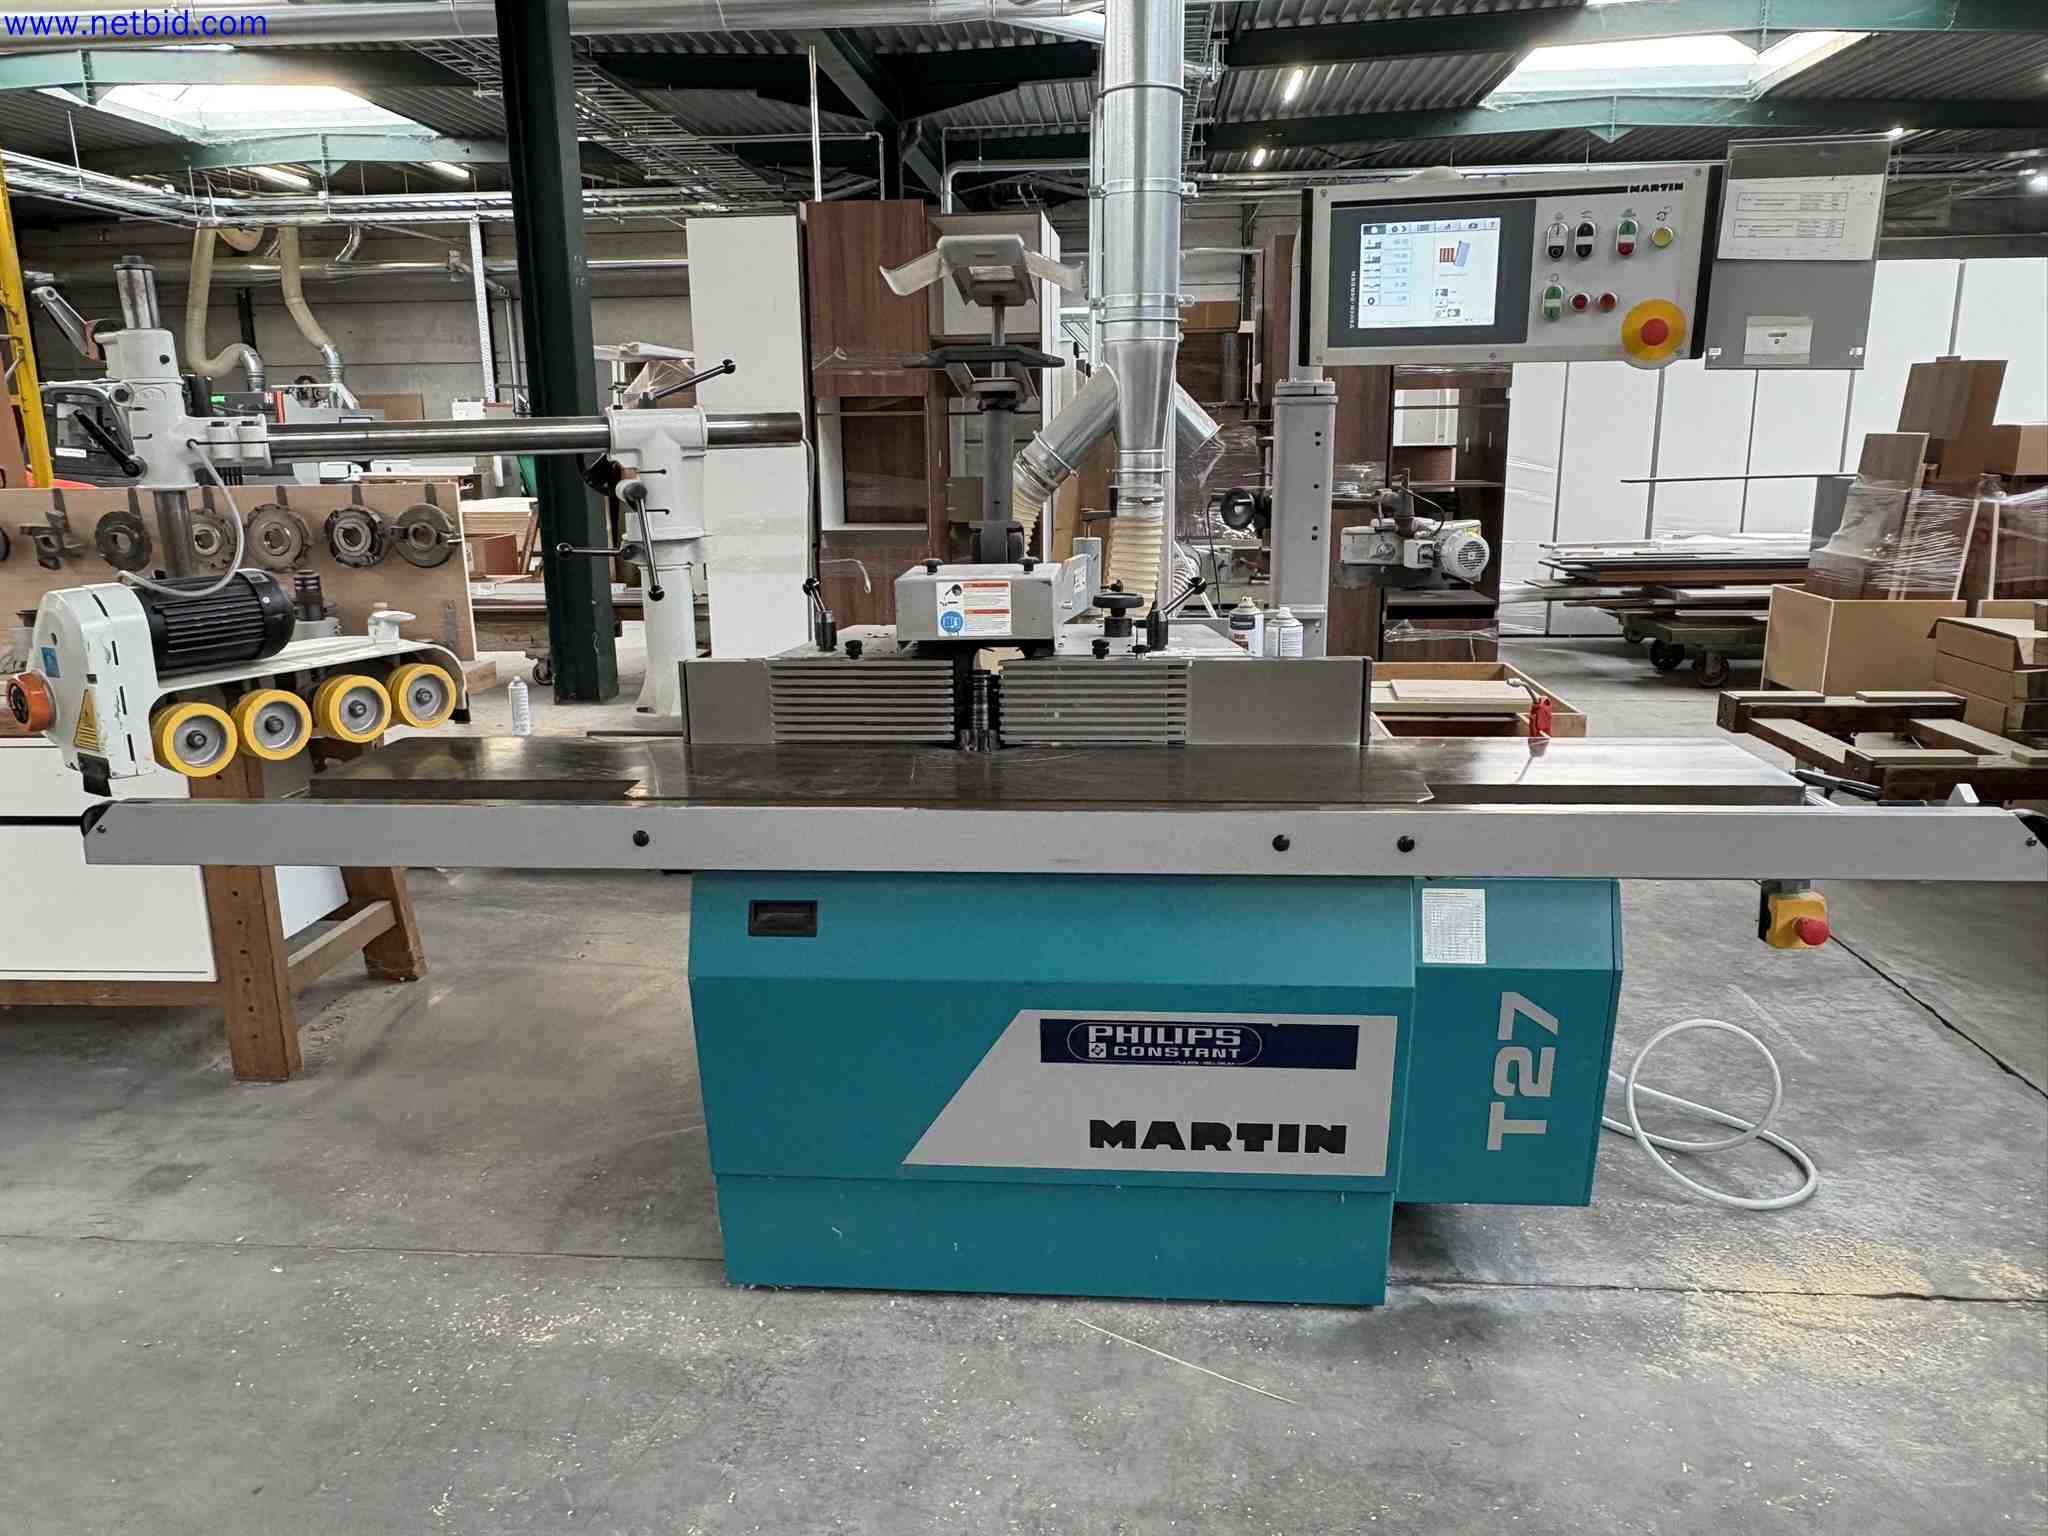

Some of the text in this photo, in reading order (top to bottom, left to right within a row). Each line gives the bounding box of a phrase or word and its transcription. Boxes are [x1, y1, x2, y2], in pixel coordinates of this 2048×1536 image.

[1629, 182, 1684, 193] MARTIN
[1088, 1025, 1241, 1046] PHILIPS
[1113, 1045, 1241, 1059] CONSTANT
[1486, 991, 1559, 1151] T27
[1089, 1119, 1347, 1154] MARTIN
